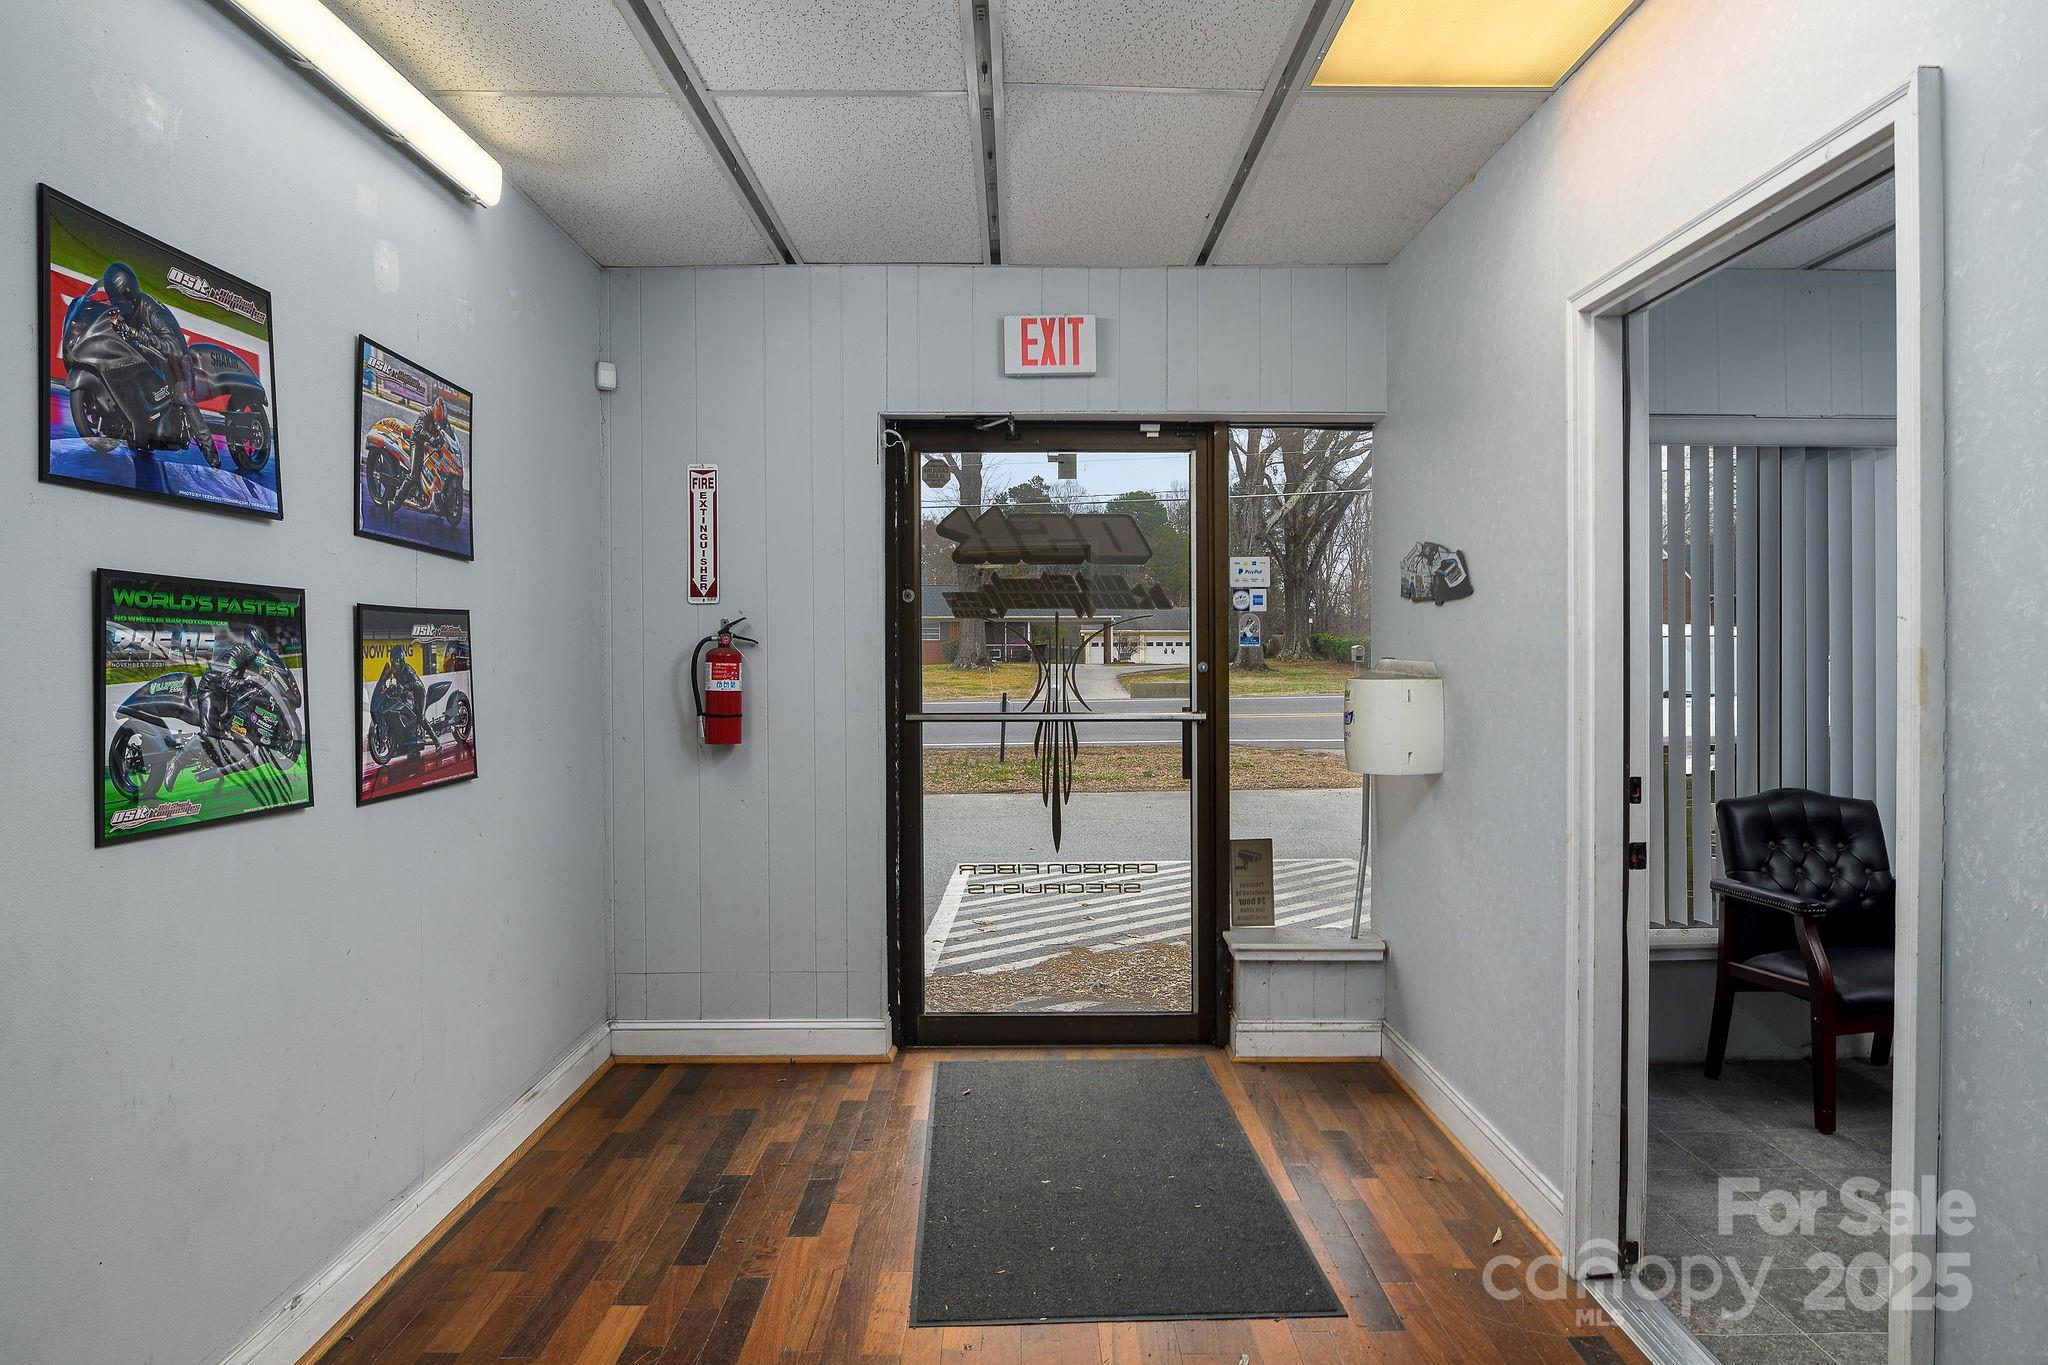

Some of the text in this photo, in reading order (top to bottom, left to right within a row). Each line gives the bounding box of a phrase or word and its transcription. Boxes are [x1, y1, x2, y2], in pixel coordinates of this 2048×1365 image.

[1021, 316, 1084, 366] EXIT
[692, 477, 715, 490] FIRE
[699, 491, 708, 591] EXTINGUISHER
[112, 588, 297, 618] WORLD'S FASTEST
[114, 614, 127, 622] NO
[362, 644, 384, 659] NOW
[111, 805, 149, 825] OSK
